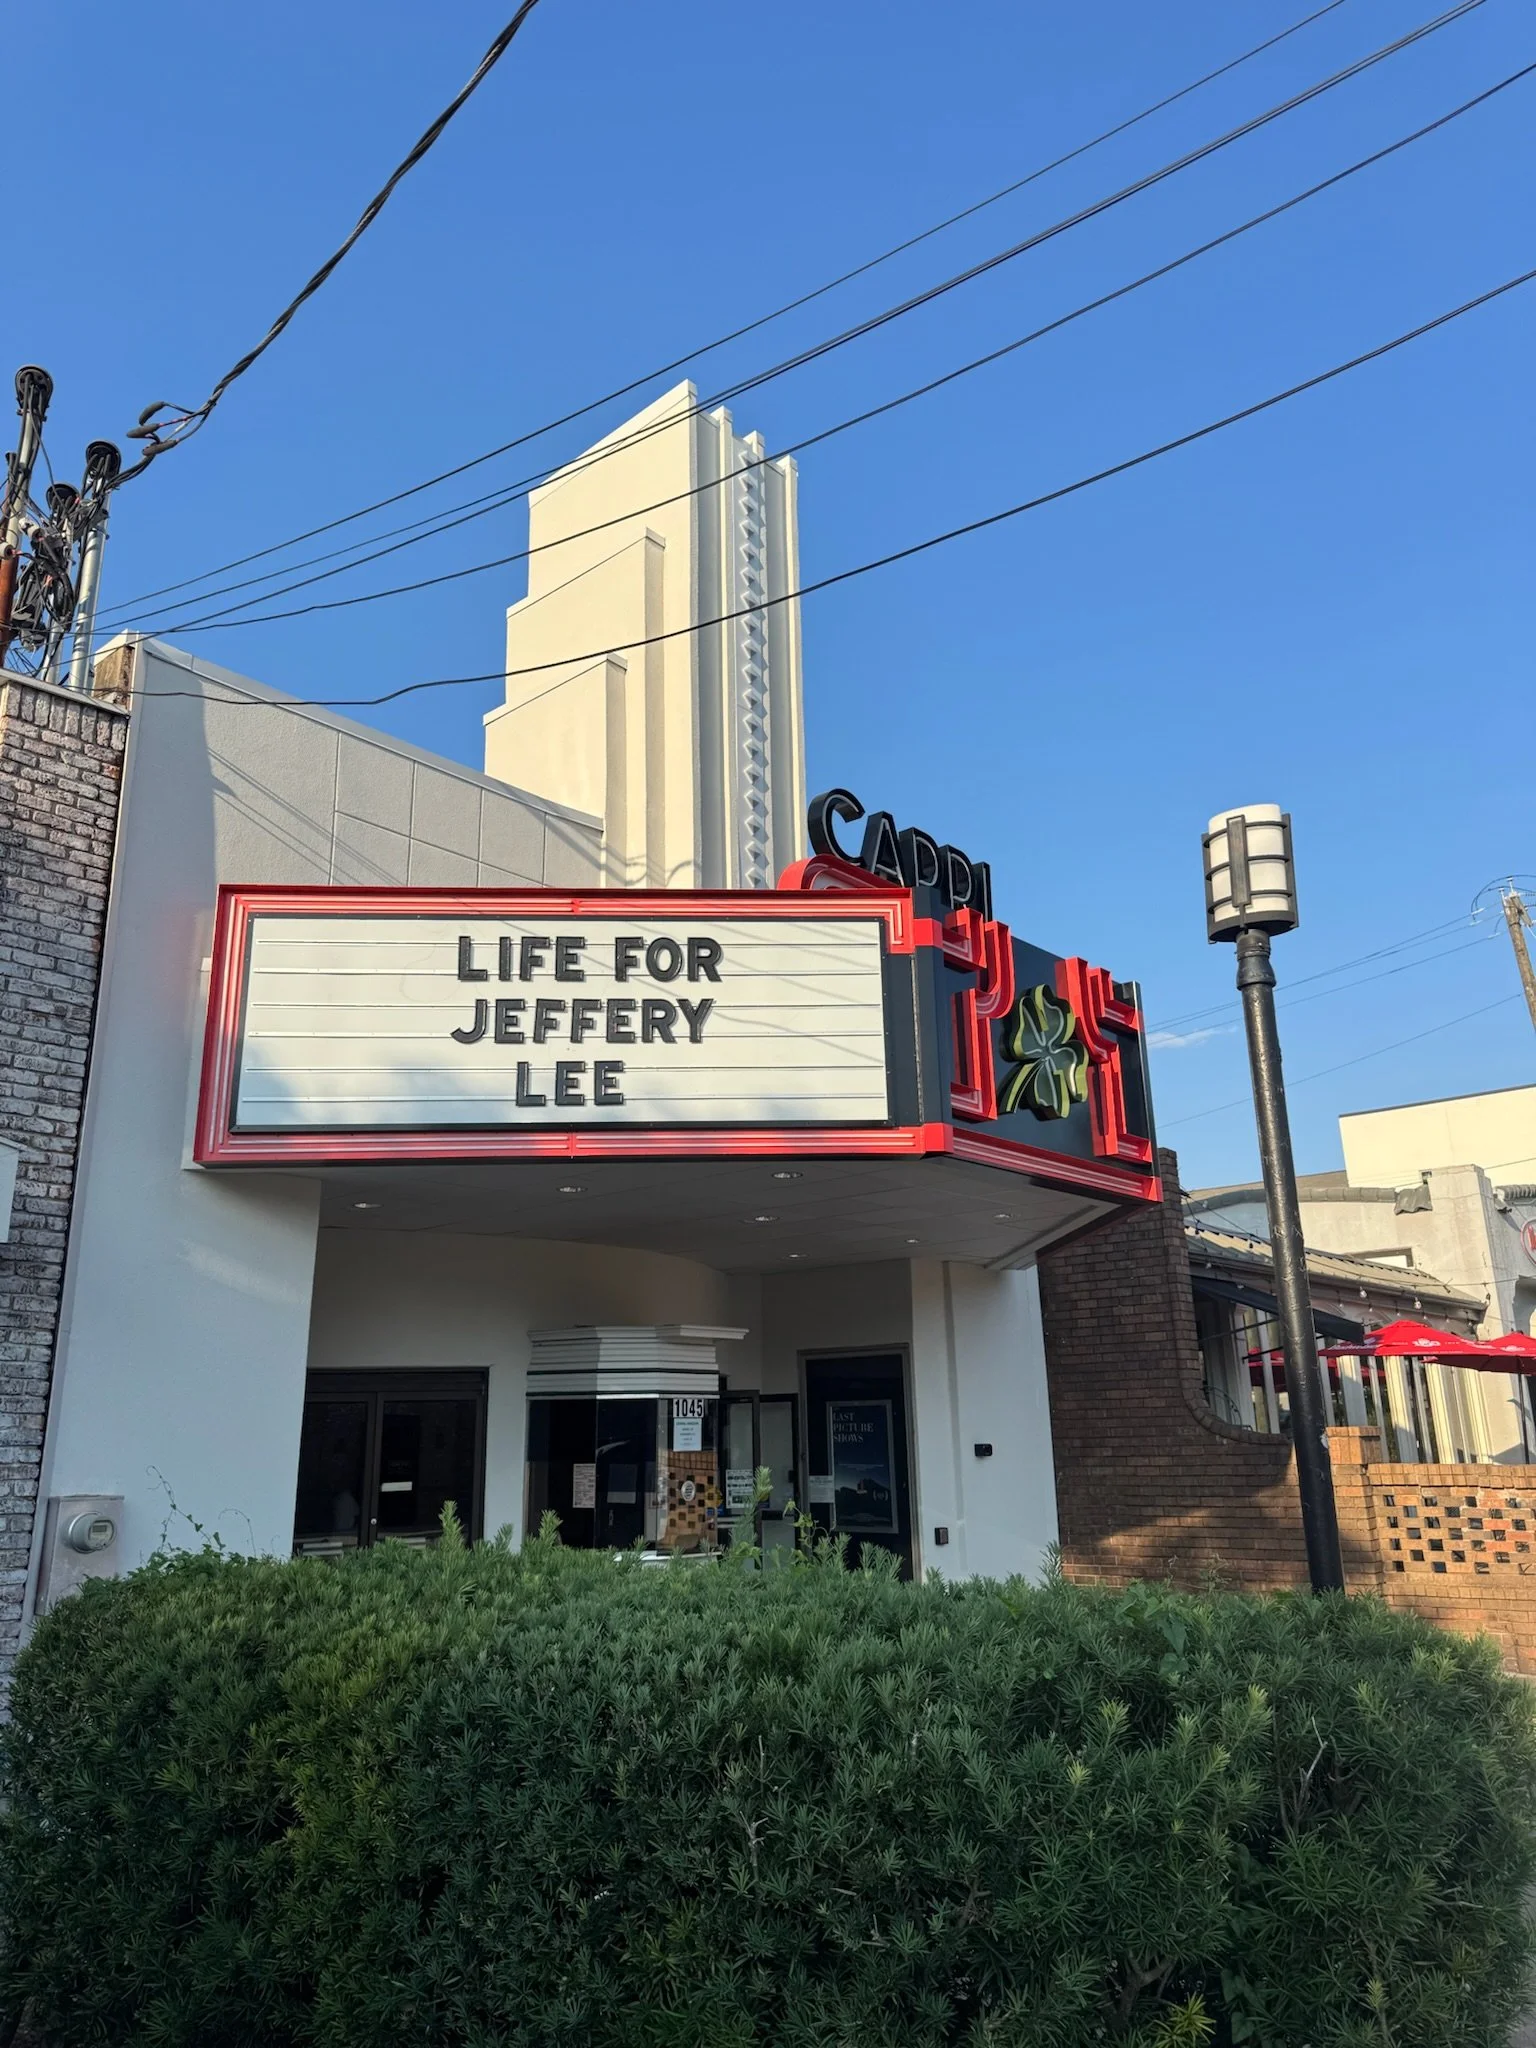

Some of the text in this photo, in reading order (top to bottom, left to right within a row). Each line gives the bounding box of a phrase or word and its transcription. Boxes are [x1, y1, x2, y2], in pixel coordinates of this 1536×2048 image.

[457, 935, 722, 983] LIFE FOR
[450, 998, 715, 1045] JEFFERY
[515, 1060, 626, 1107] LEE
[675, 1399, 703, 1417] 1045
[833, 1412, 856, 1421] LAST
[833, 1422, 875, 1433] PICTURE
[833, 1433, 864, 1443] SHOWS
